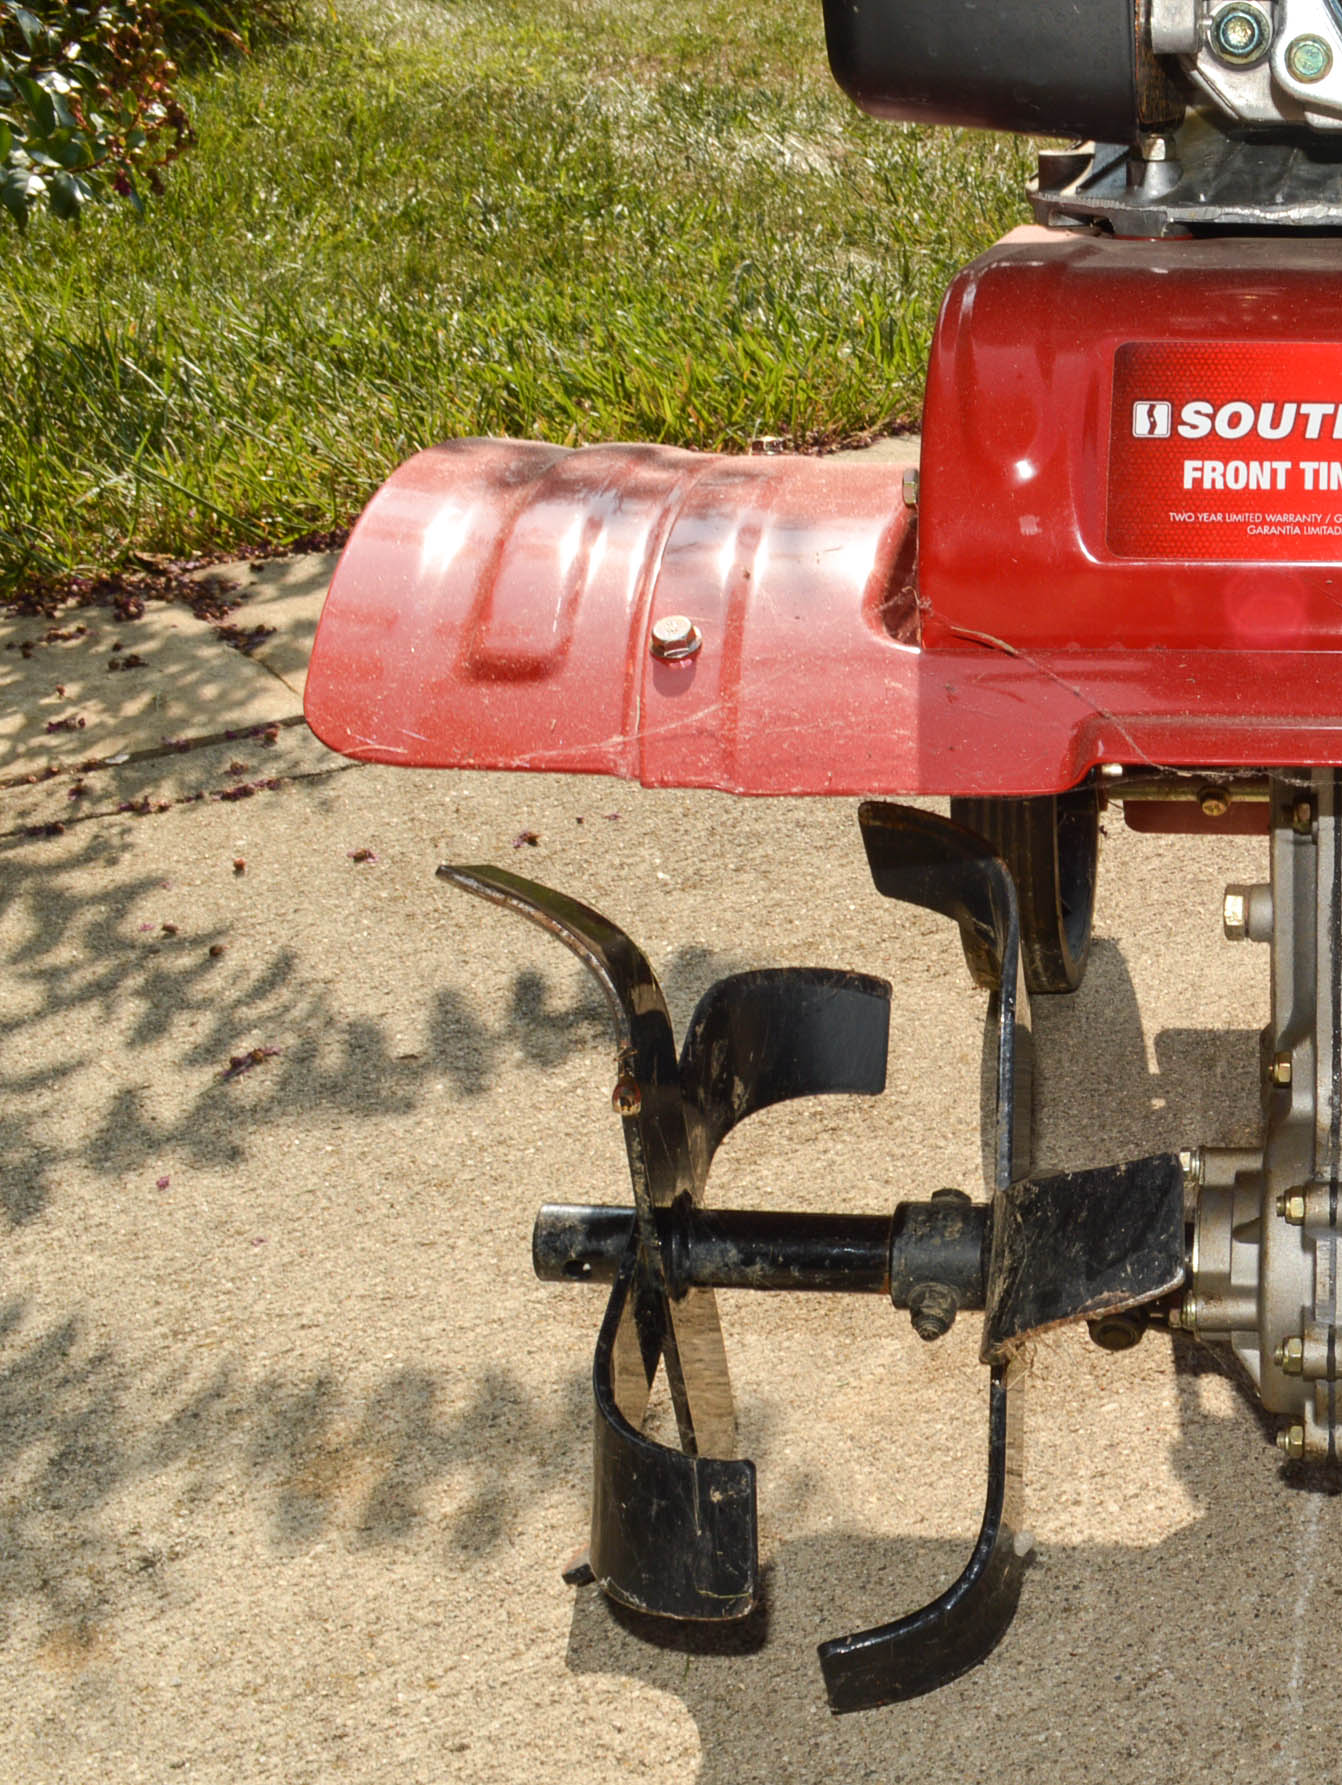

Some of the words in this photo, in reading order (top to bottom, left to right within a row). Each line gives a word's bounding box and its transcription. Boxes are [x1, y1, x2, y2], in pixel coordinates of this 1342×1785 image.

[1183, 460, 1292, 490] FRONT
[1169, 512, 1195, 522] TWO
[1197, 512, 1223, 523] YEAR
[1225, 513, 1263, 523] LIMITED
[1265, 513, 1323, 524] WARRANTY
